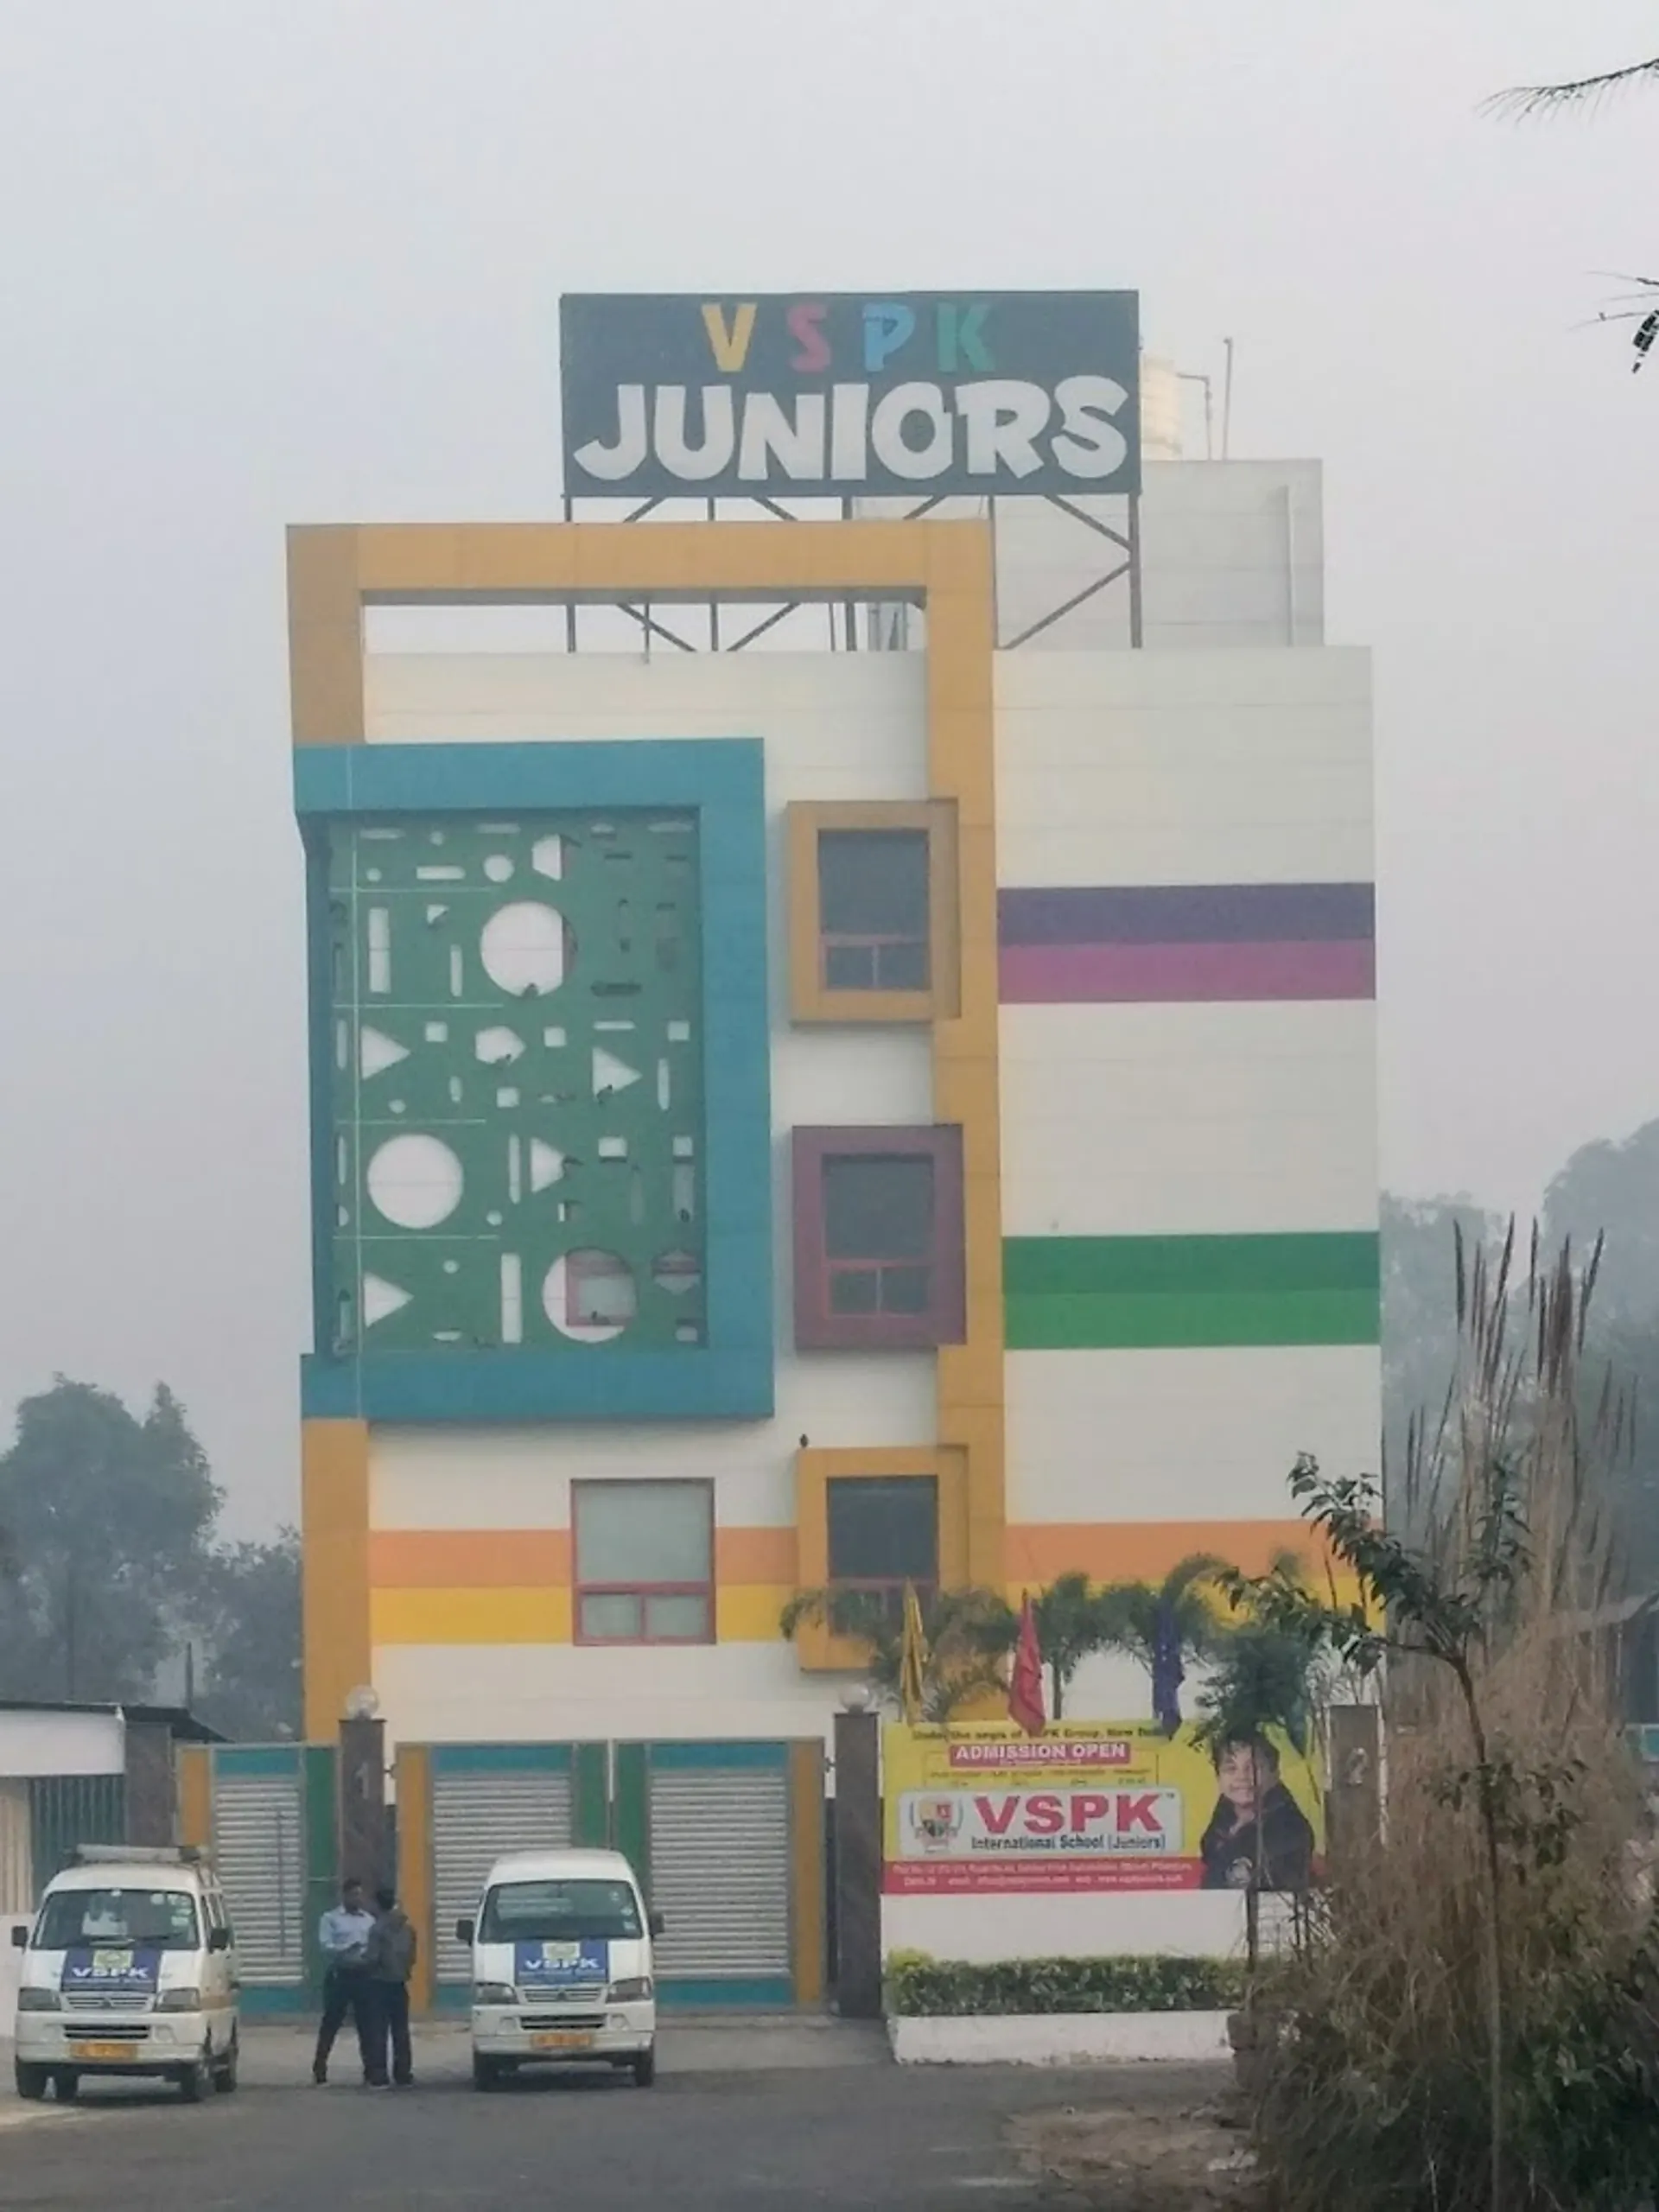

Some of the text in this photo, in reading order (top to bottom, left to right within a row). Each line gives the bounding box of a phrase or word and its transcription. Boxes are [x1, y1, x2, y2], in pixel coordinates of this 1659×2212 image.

[573, 375, 1128, 481] JUNIORS
[955, 1743, 1126, 1760] ADMISSION OPEN
[973, 1793, 1163, 1834] VSPK
[971, 1835, 1056, 1849] International
[1060, 1834, 1105, 1849] School
